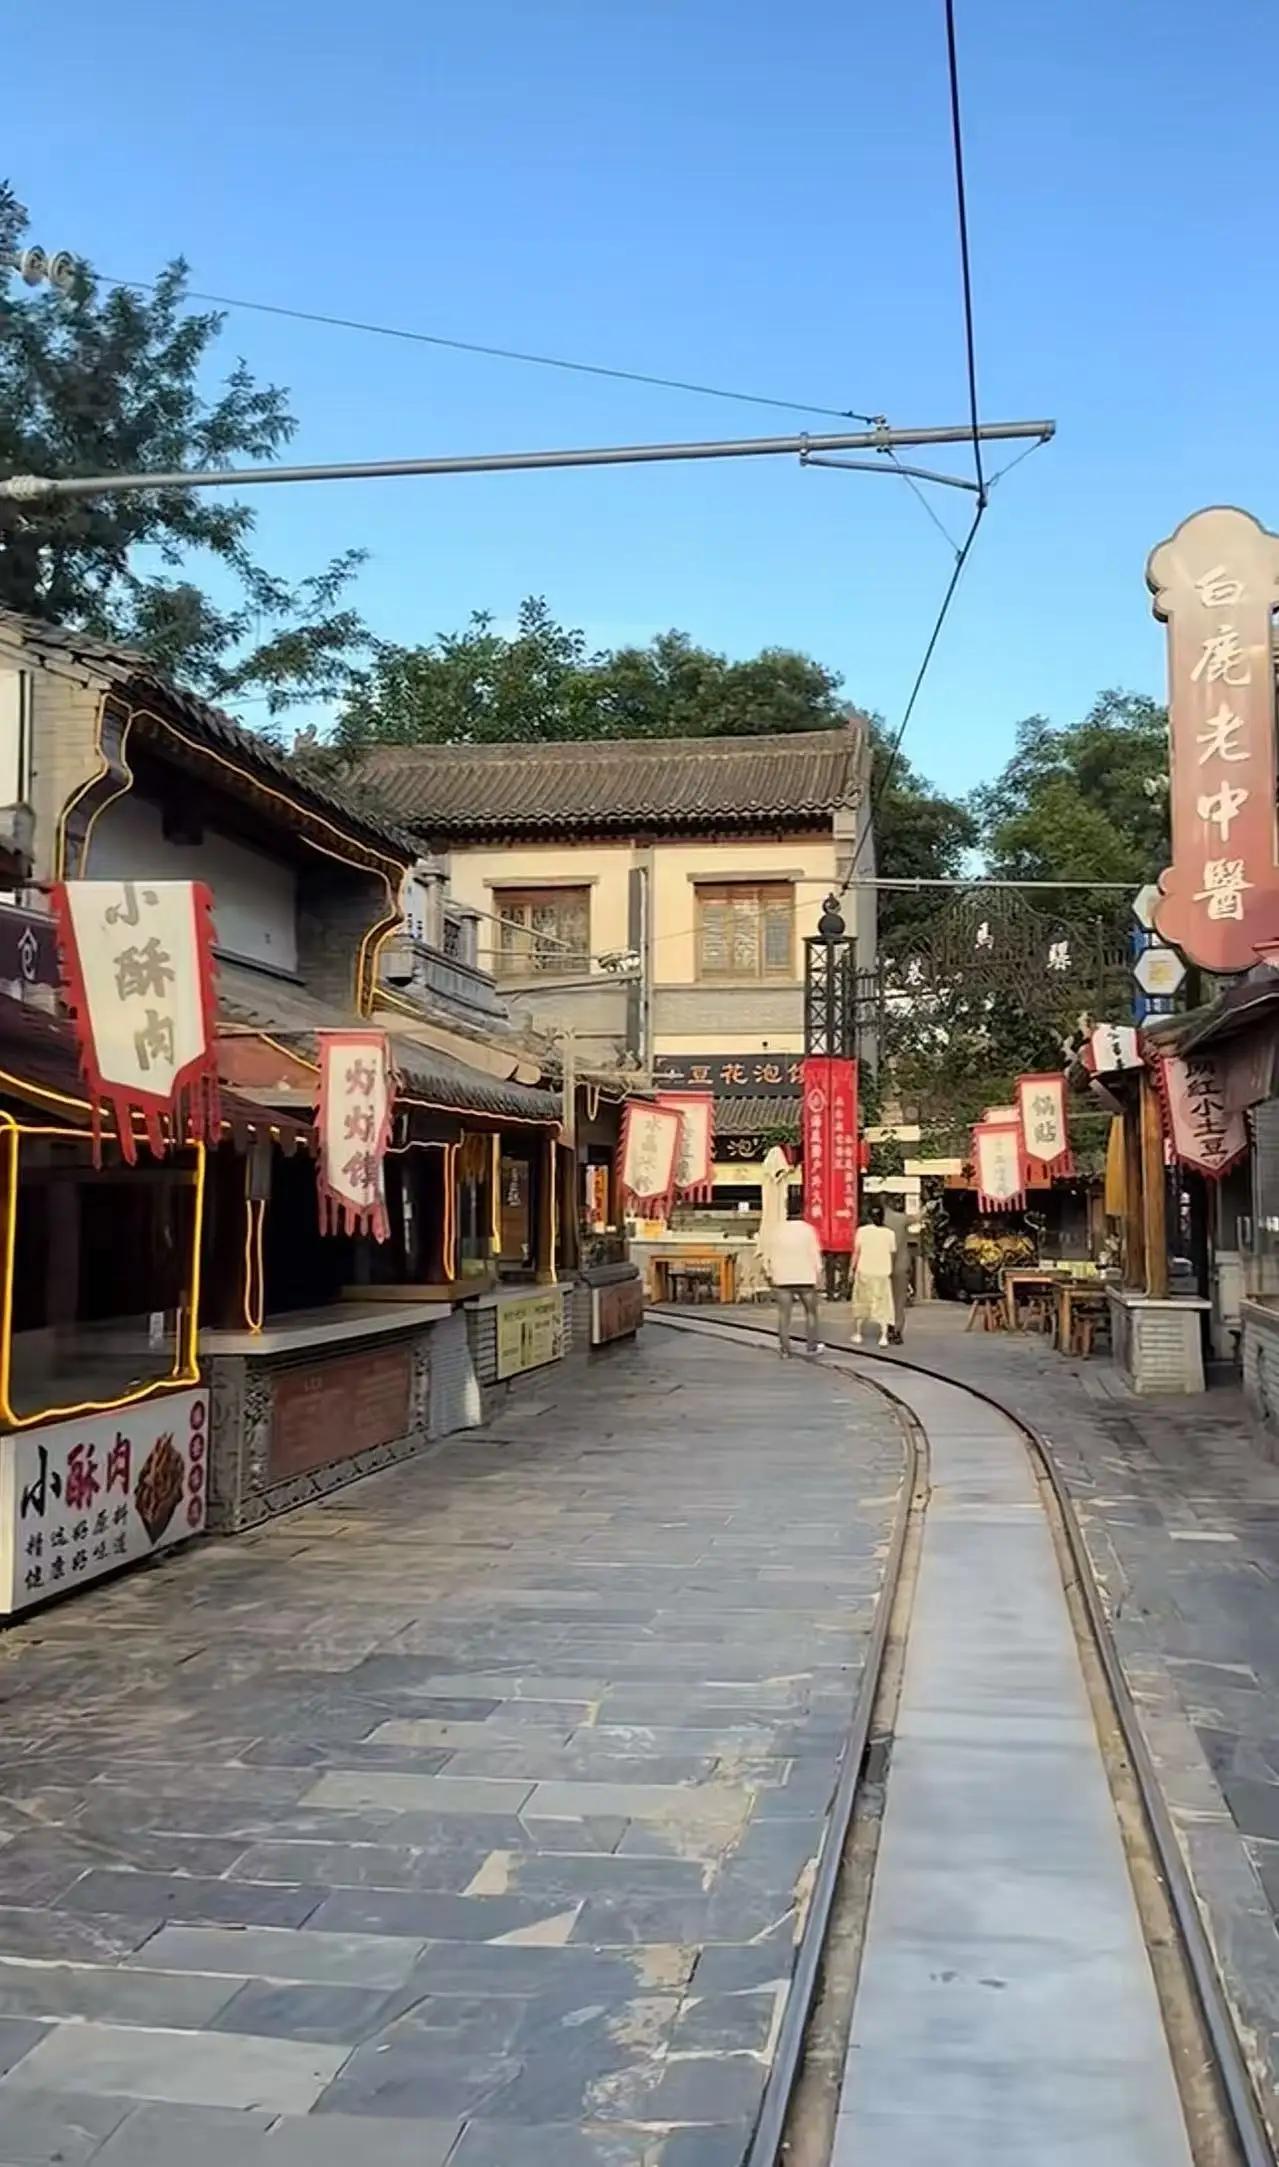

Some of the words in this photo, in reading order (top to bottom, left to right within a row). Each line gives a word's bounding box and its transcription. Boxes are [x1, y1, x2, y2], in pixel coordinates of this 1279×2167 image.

[1190, 564, 1256, 922] 白鹿老中醫
[104, 881, 175, 1071] 小酥肉
[21, 1432, 132, 1519] 小酥肉
